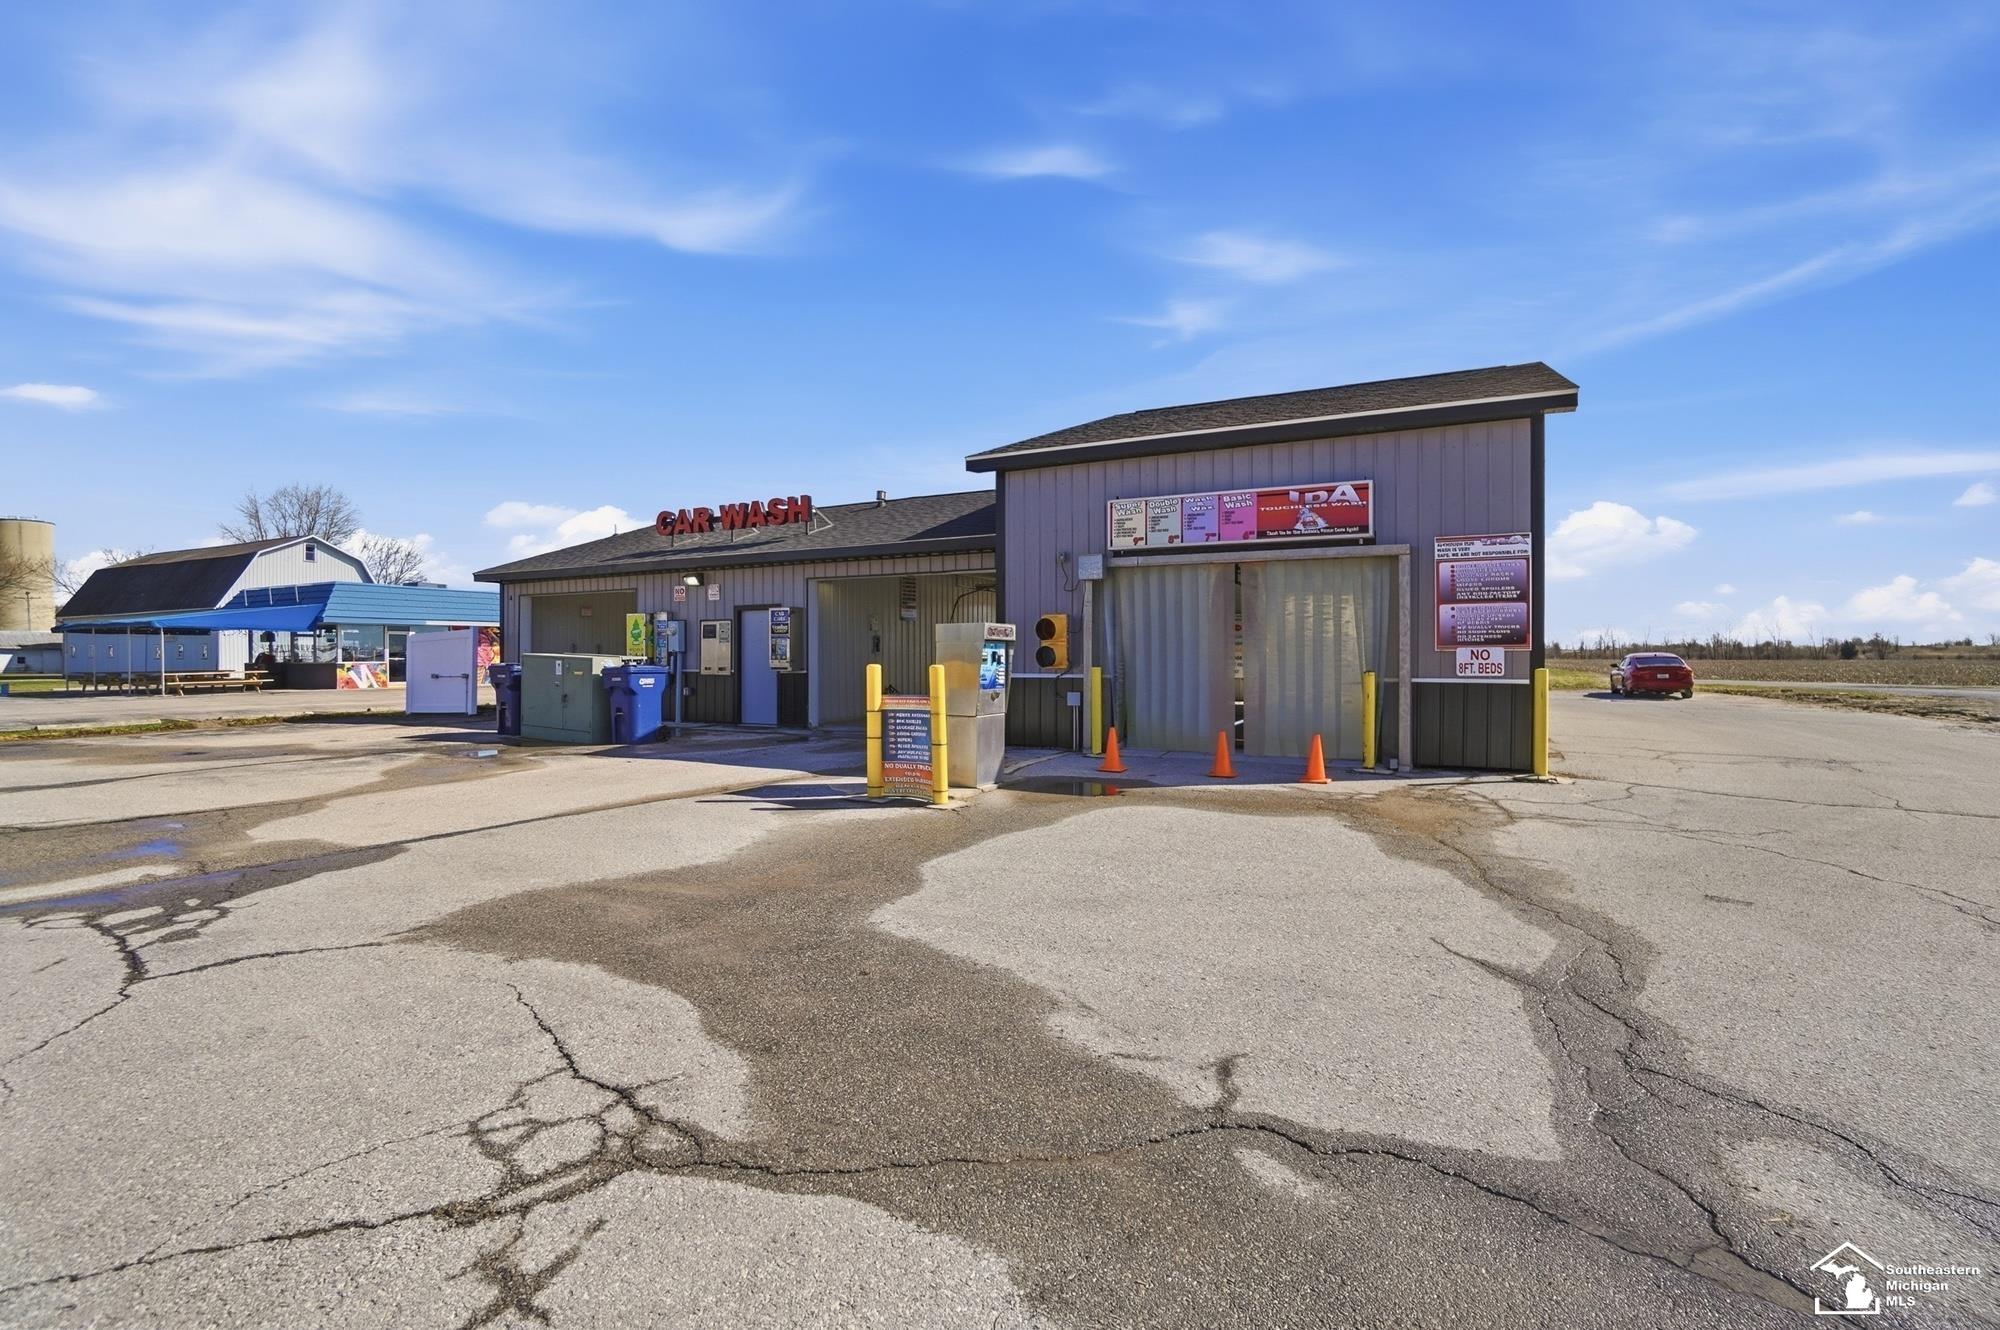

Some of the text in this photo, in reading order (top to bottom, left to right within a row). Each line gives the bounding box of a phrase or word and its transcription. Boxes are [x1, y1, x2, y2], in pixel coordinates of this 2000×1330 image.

[1223, 494, 1251, 502] Basic
[1149, 499, 1178, 508] Double
[1224, 501, 1252, 509] Wash
[1260, 503, 1327, 512] TOUCHLESS
[656, 495, 812, 536] CAR WASH
[1116, 508, 1142, 516] Wash
[1153, 507, 1177, 515] Wash
[1470, 649, 1490, 661] NO
[1458, 663, 1503, 674] 8FT. BEDS
